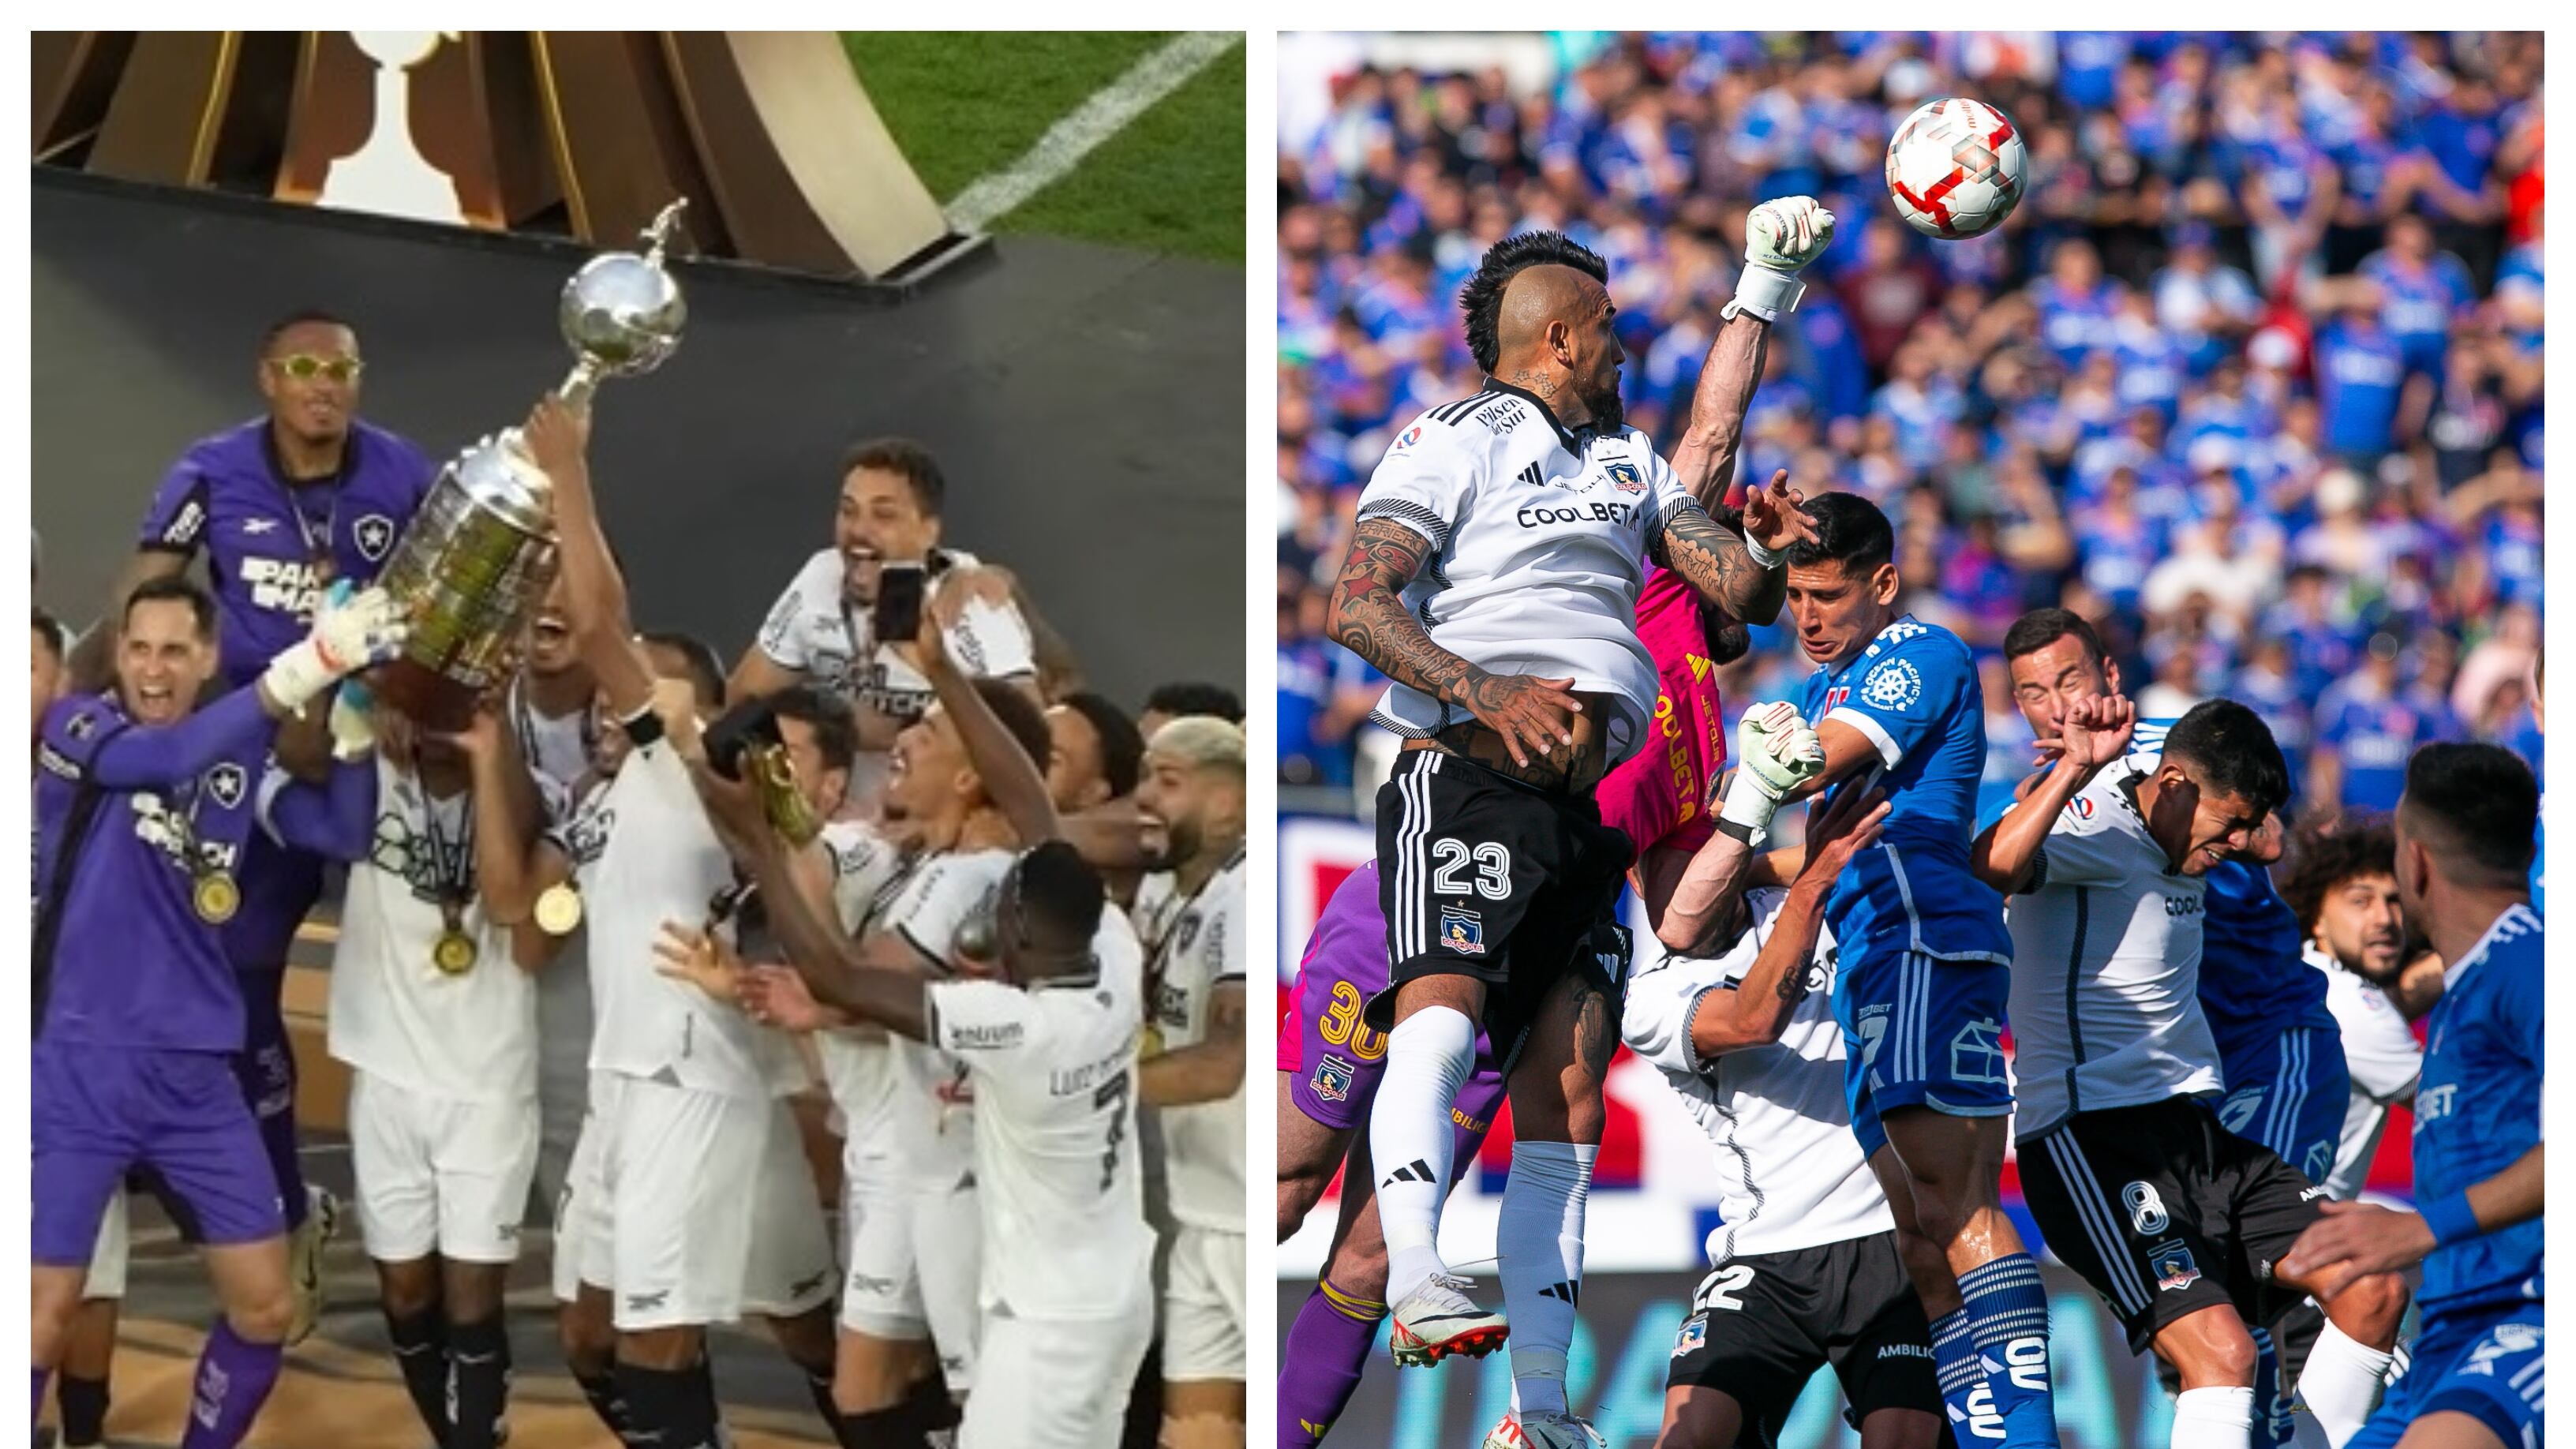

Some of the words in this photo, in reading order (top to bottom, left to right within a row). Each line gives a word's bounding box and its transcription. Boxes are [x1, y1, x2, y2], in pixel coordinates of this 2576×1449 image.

[1476, 398, 1521, 428] Pilsen
[1500, 406, 1527, 435] Sur
[1517, 503, 1631, 529] COOLBET
[1655, 695, 1695, 799] OOLBET
[1701, 695, 1720, 762] JETOUR
[1432, 837, 1512, 900] 23
[1443, 938, 1483, 952] COLO-COLO
[1320, 980, 1390, 1060] 30
[1312, 1080, 1344, 1099] COLO-COLO
[2121, 1181, 2169, 1235] 8
